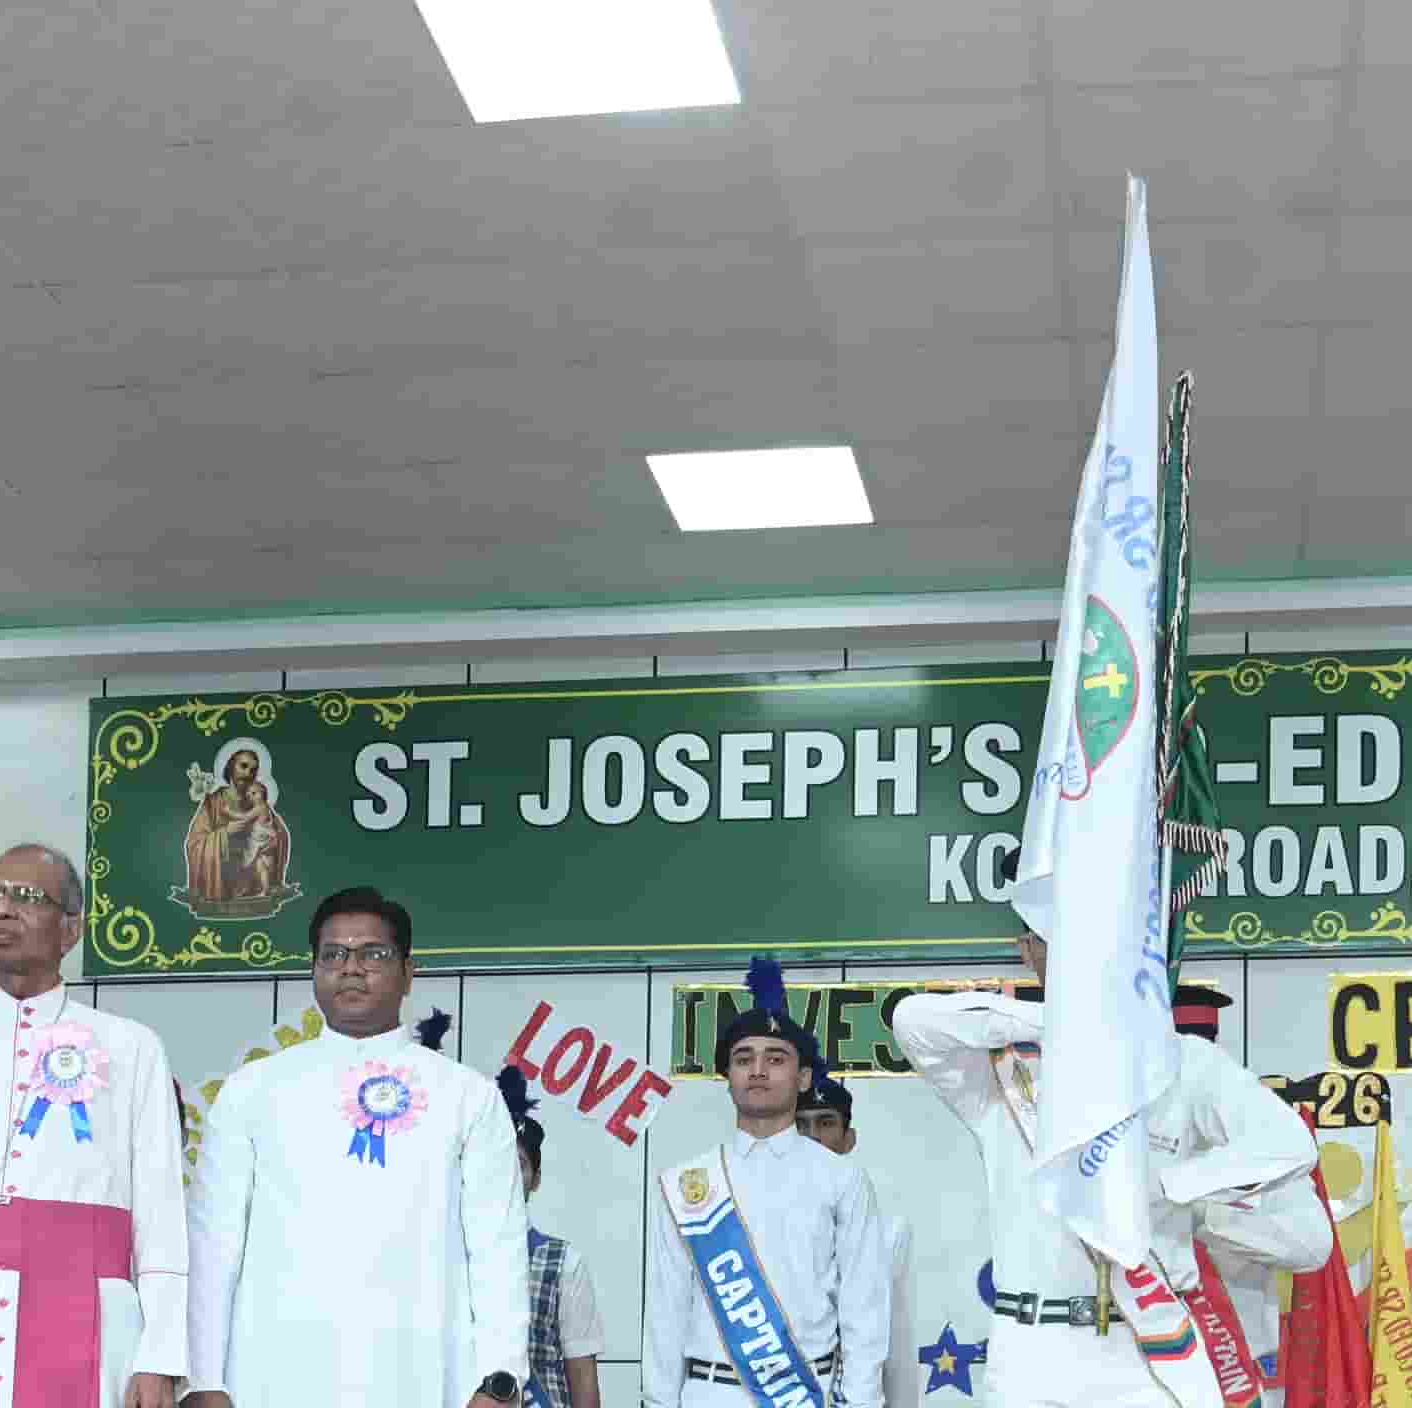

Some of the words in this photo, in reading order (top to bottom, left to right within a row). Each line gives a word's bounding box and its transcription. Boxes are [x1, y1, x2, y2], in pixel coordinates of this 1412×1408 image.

[352, 741, 483, 830] ST.
[519, 722, 1022, 825] JOSEPH'S
[1197, 715, 1401, 806] -ED
[506, 1000, 673, 1147] LOVE
